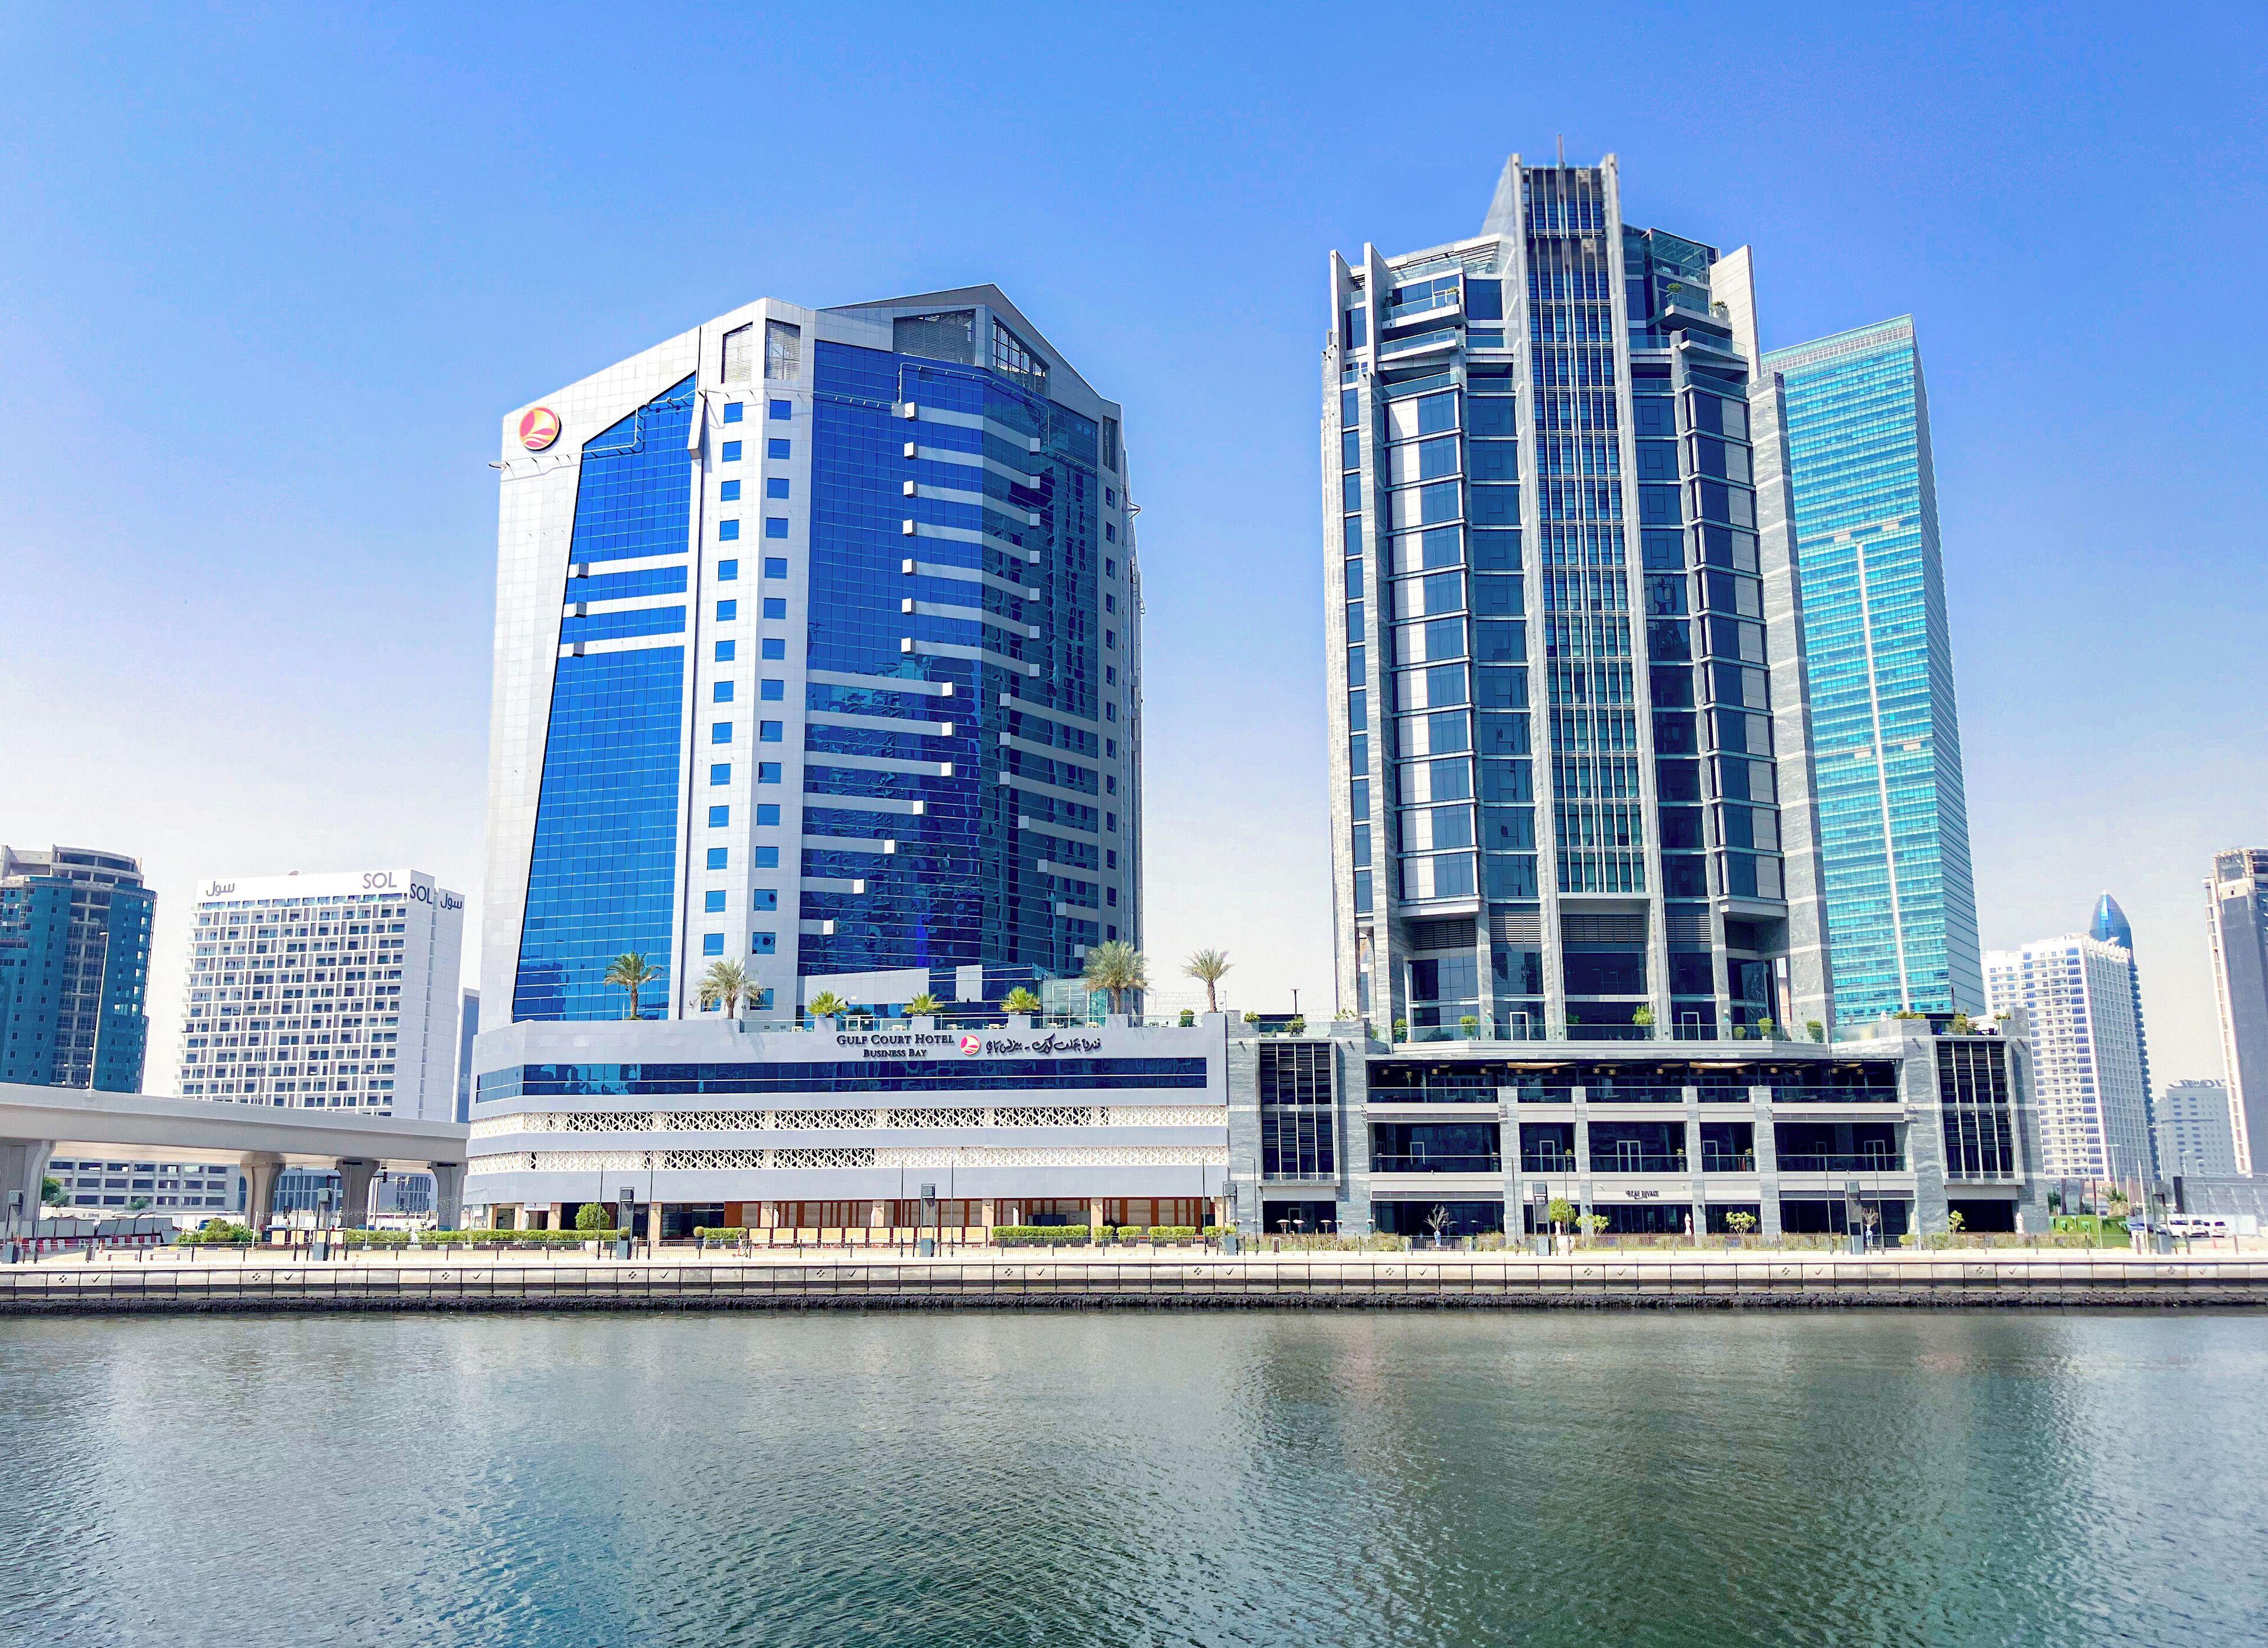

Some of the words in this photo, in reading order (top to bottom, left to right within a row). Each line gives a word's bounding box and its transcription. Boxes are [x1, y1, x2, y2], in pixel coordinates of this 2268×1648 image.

[206, 880, 236, 897] سول
[363, 872, 397, 889] SOL
[410, 883, 434, 905] SOL
[440, 892, 462, 910] سول
[836, 1035, 868, 1045] GULF
[871, 1034, 912, 1045] COURT
[915, 1033, 954, 1044] HOTEL
[863, 1049, 906, 1058] BUSINESS
[908, 1048, 928, 1057] BAY
